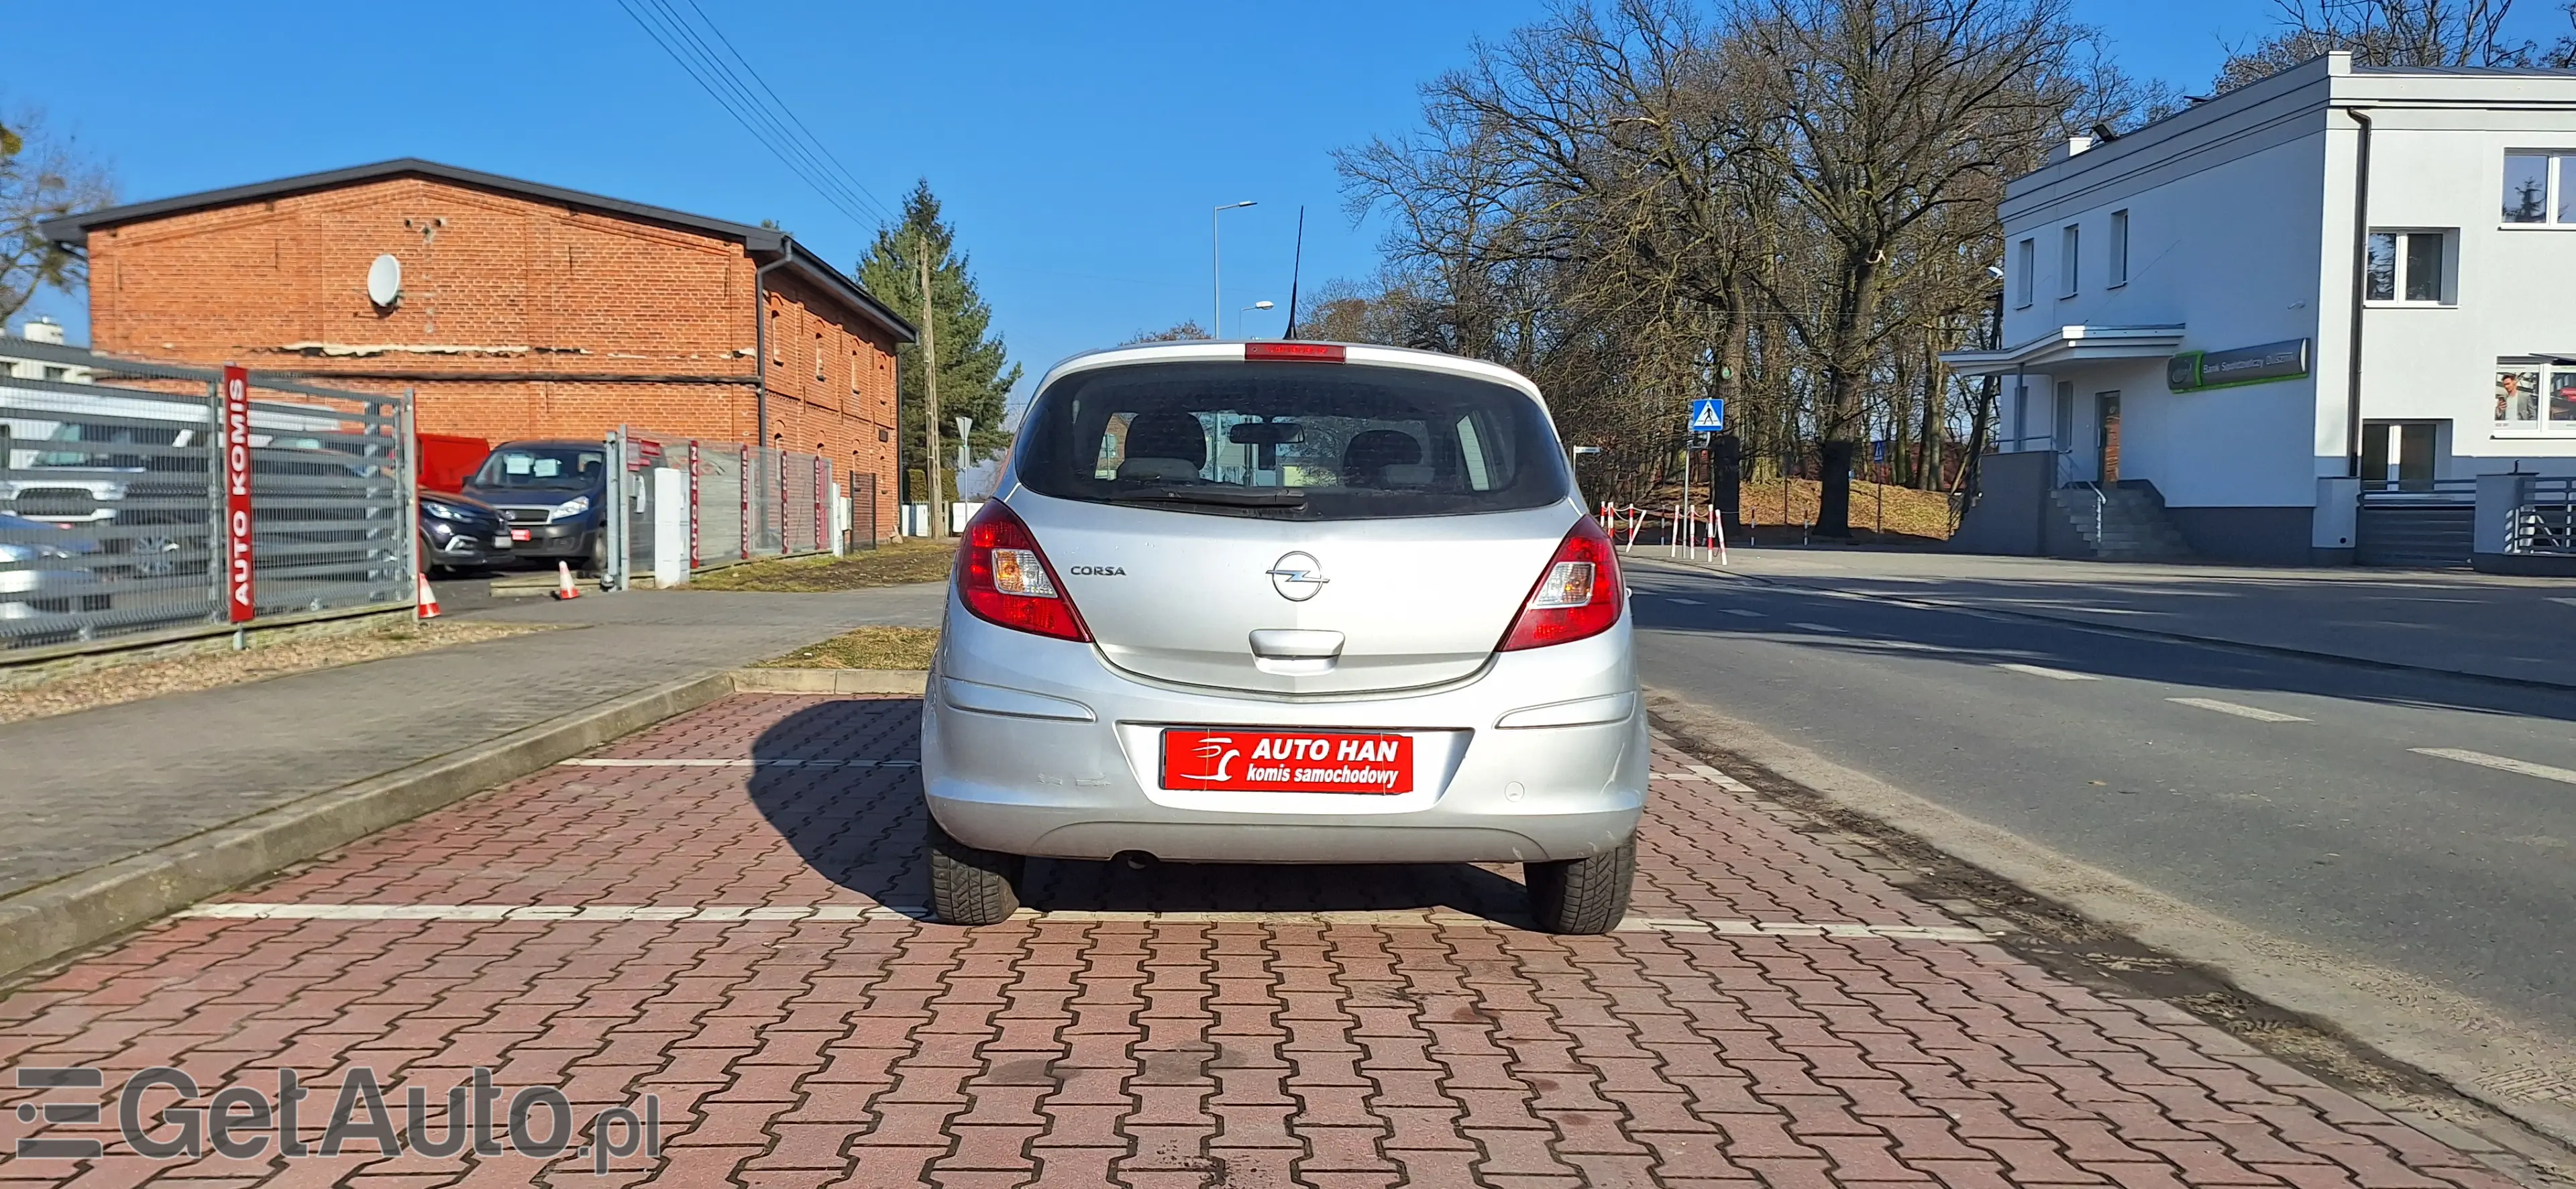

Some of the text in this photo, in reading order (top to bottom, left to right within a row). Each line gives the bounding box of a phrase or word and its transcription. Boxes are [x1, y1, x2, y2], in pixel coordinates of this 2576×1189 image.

[229, 379, 249, 606] AUTO KOMIS
[1071, 566, 1126, 575] CORSA
[1251, 738, 1399, 762] AUTO HAN
[1246, 764, 1399, 788] komis samochodowy
